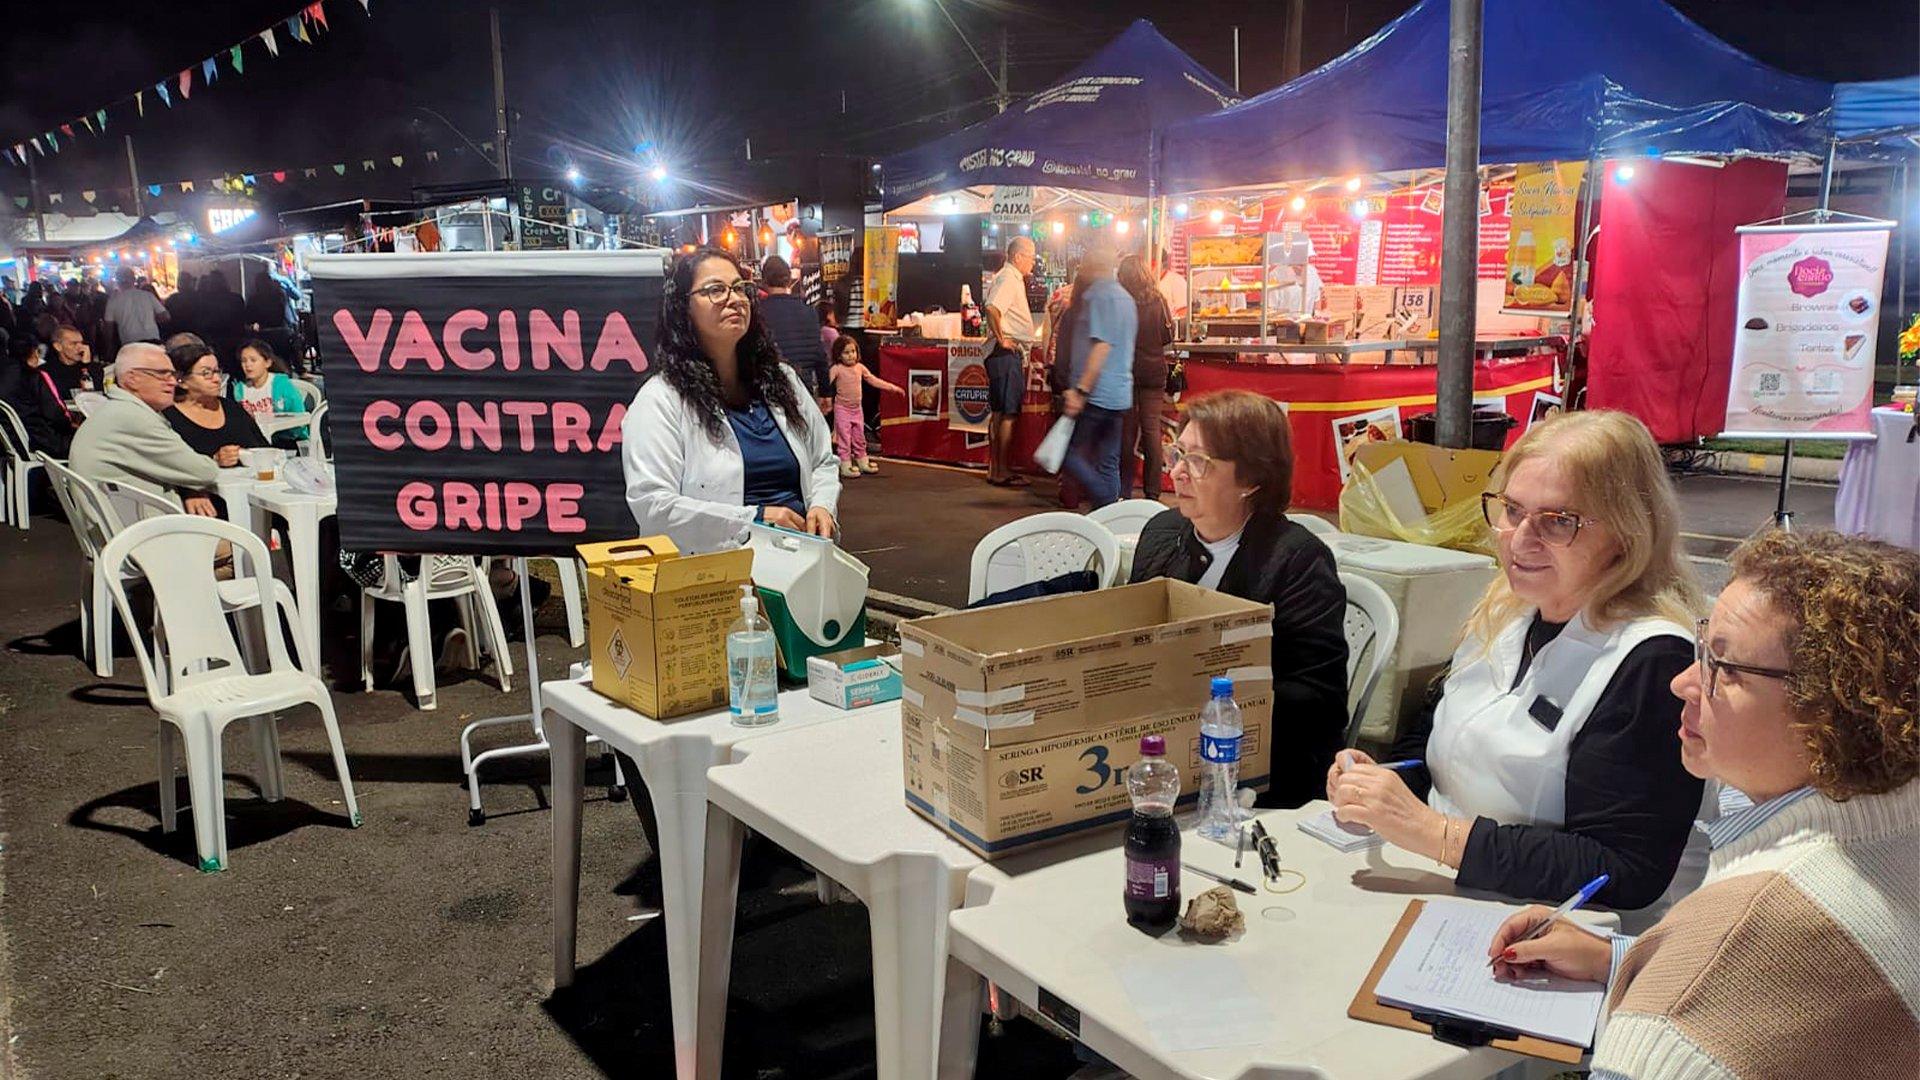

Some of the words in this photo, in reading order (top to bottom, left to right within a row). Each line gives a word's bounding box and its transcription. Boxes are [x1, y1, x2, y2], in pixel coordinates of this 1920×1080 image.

[993, 203, 1031, 215] CAIXA
[333, 308, 649, 373] VACINA
[396, 482, 587, 533] GRIPE
[999, 747, 1039, 761] SERINGA
